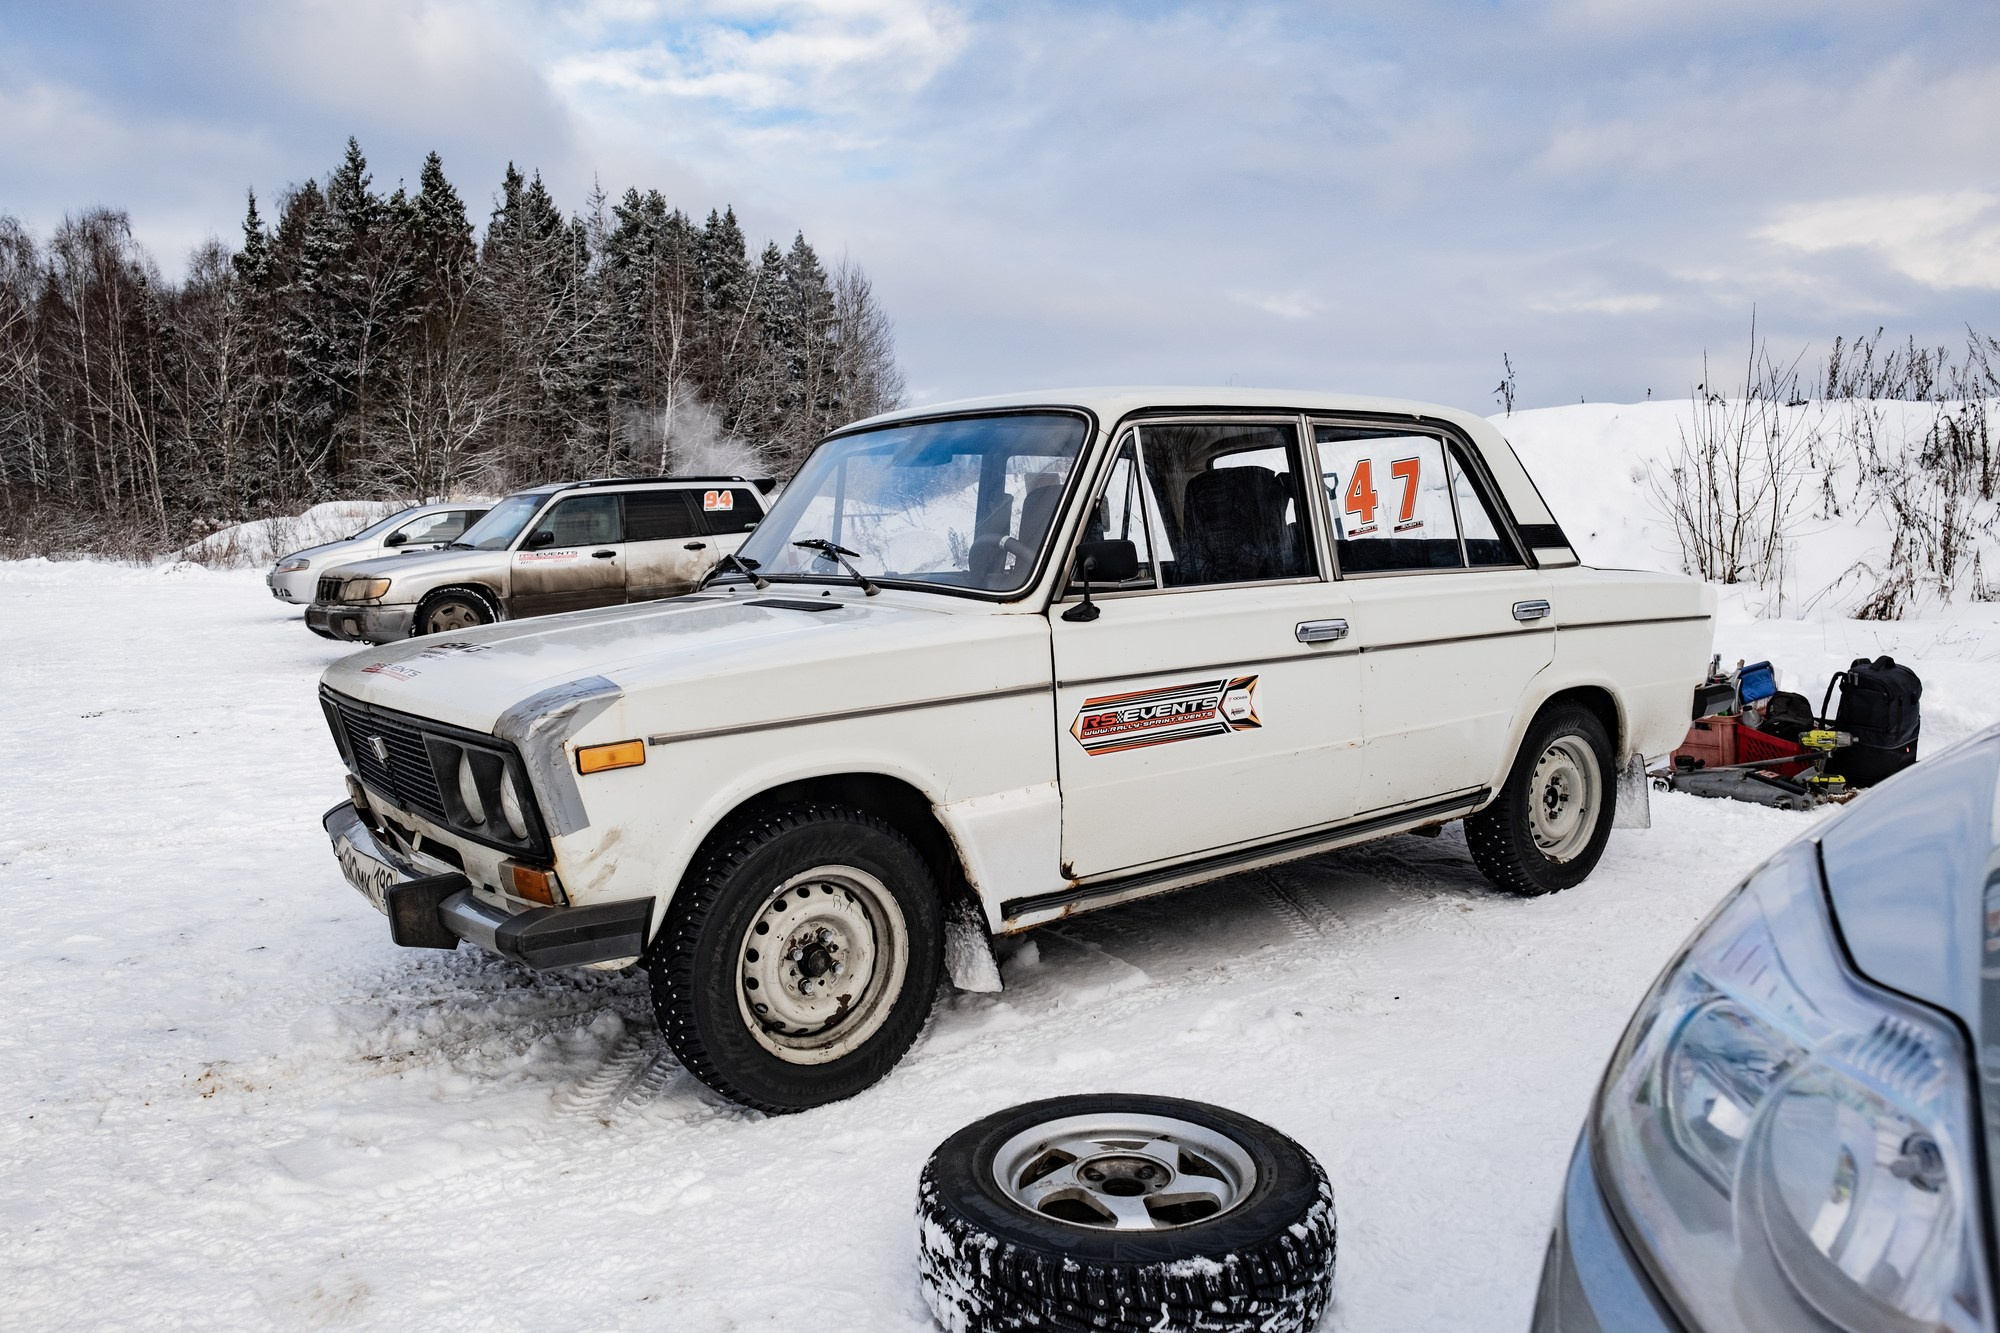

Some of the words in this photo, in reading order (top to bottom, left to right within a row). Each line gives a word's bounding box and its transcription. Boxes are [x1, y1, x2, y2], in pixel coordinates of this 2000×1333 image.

[704, 491, 733, 508] 94
[1345, 456, 1420, 524] 47
[1083, 713, 1117, 729] RS
[1123, 697, 1218, 722] EVENTS
